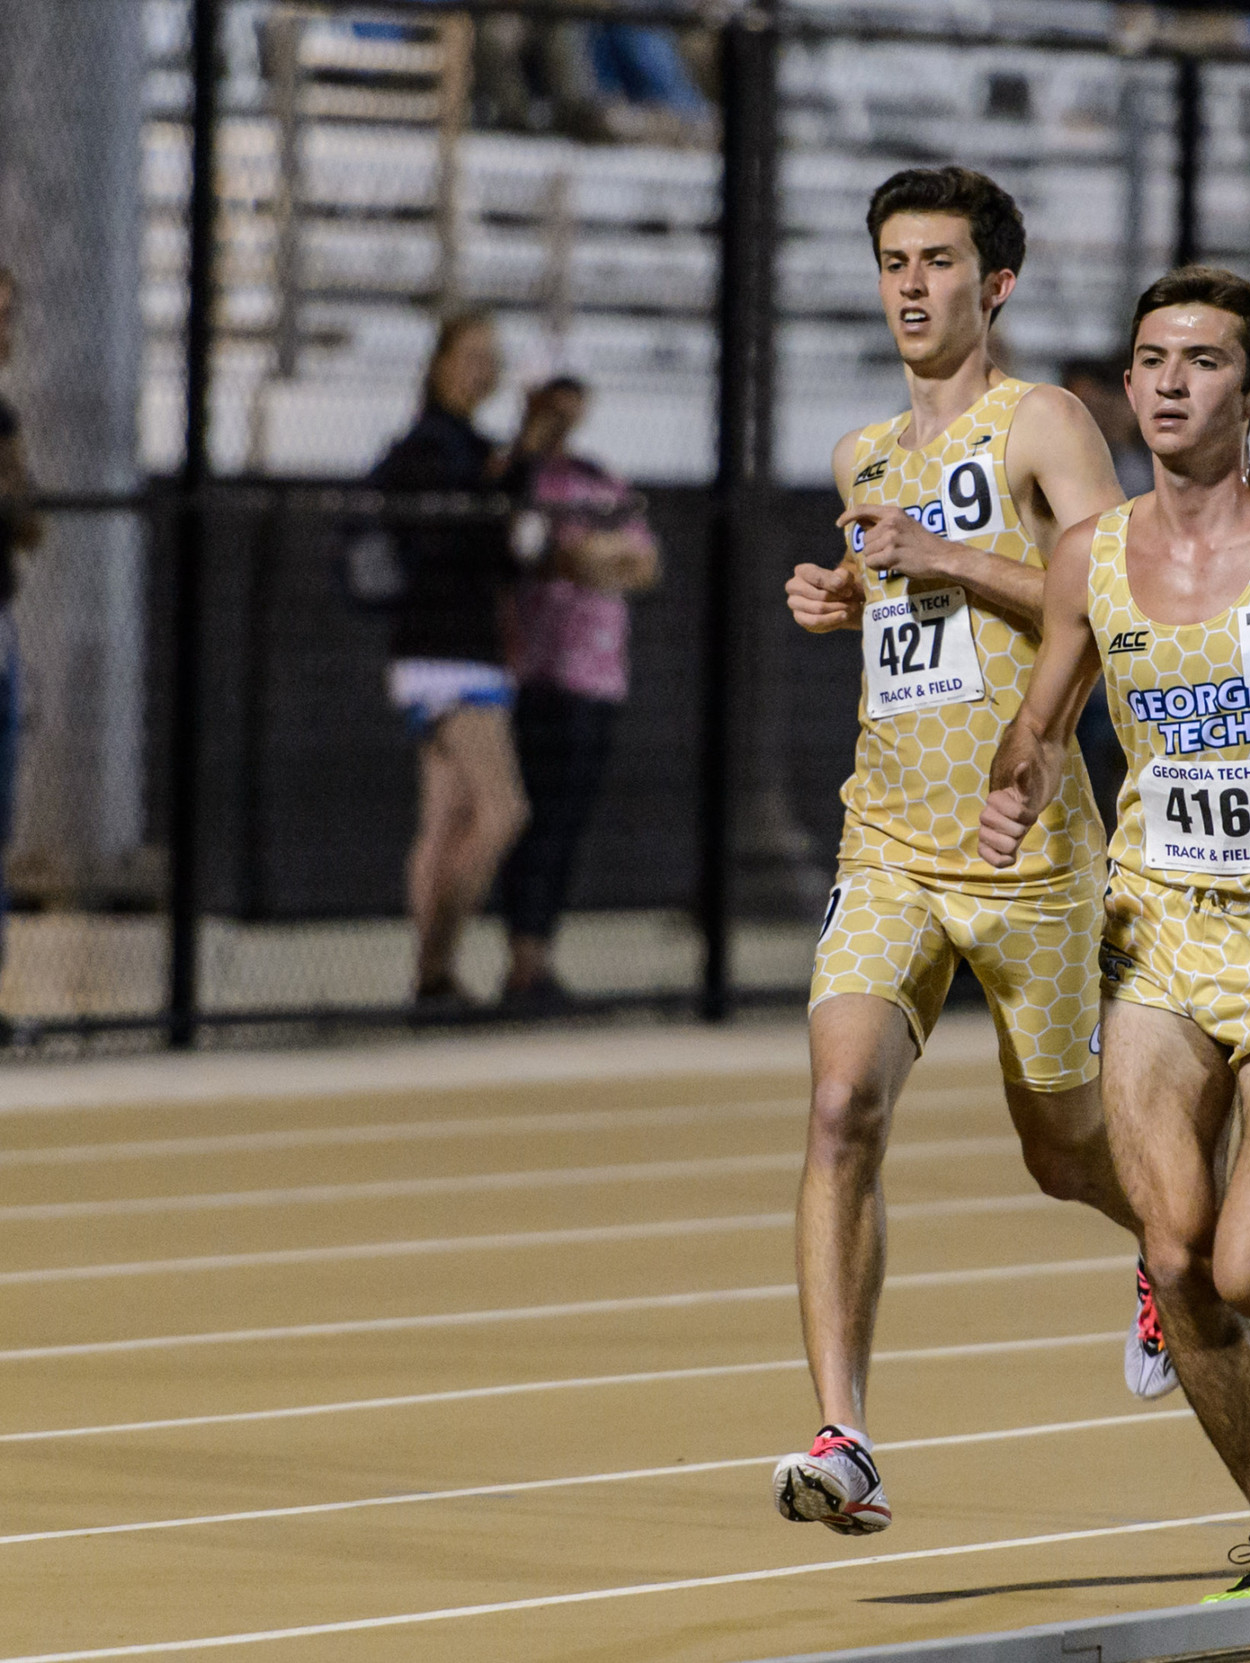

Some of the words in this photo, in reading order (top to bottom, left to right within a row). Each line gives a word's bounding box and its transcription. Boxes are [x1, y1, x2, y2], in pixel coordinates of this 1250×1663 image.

[855, 459, 888, 482] ACC
[948, 461, 992, 532] 9
[872, 599, 918, 622] GEORGIA
[920, 595, 950, 612] TECH
[880, 615, 945, 676] 427
[1109, 631, 1150, 650] ACC
[880, 685, 912, 704] TRACK
[916, 684, 925, 697] &
[929, 678, 963, 693] FIELD
[1152, 765, 1214, 780] GEORGIA
[1166, 787, 1250, 837] 416
[1165, 845, 1206, 860] TRACK
[1210, 849, 1219, 862] &
